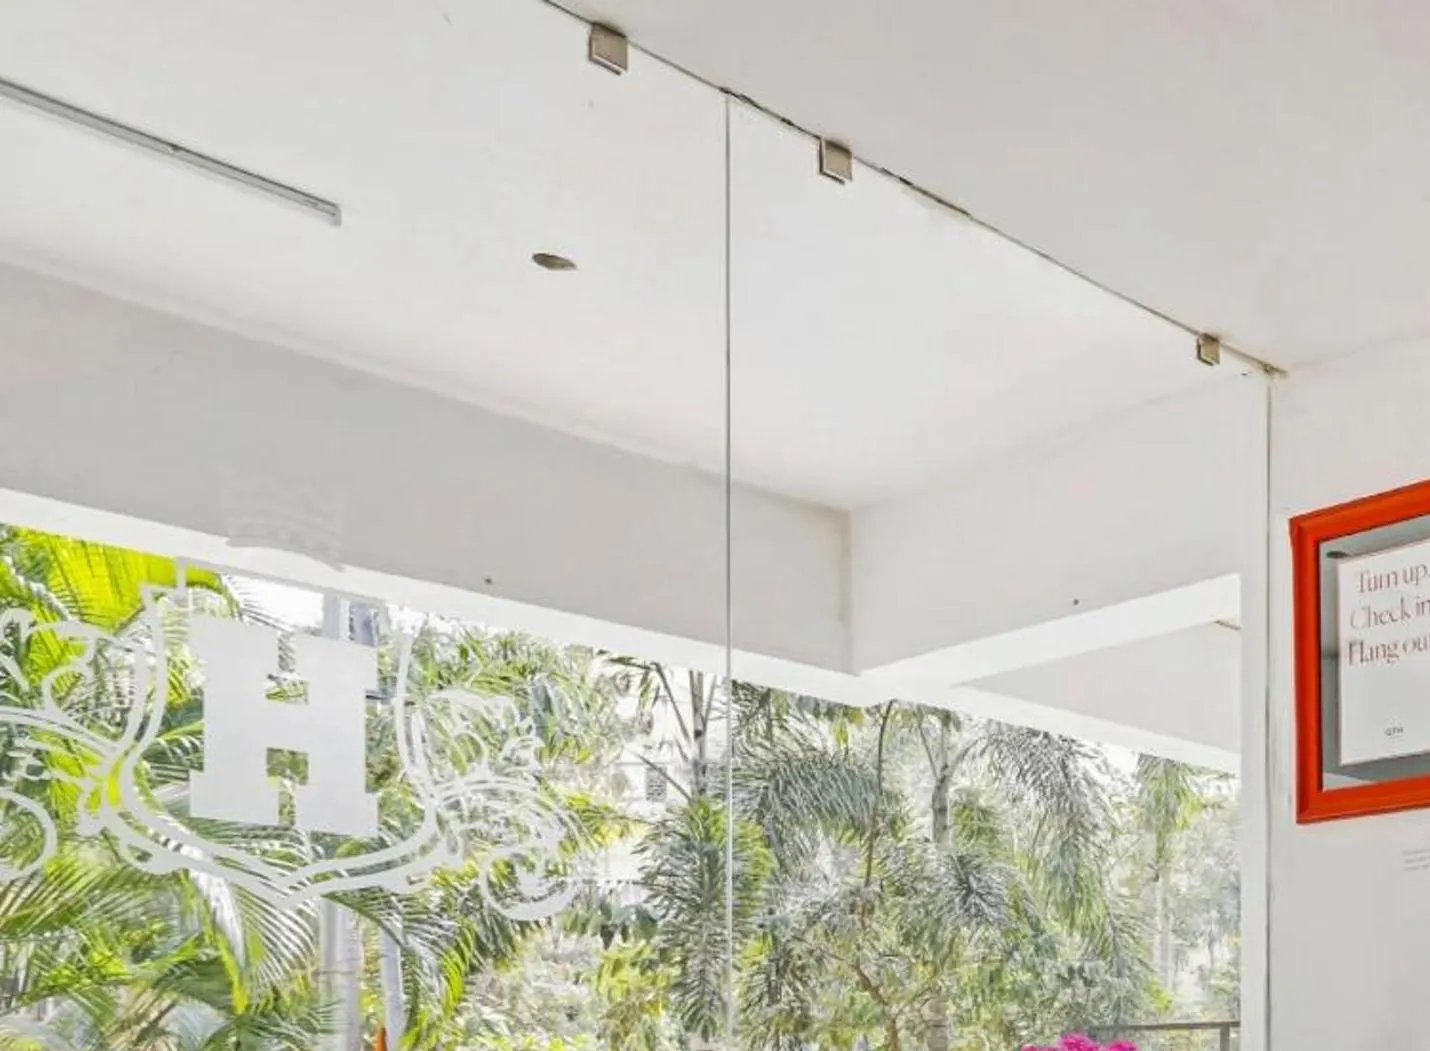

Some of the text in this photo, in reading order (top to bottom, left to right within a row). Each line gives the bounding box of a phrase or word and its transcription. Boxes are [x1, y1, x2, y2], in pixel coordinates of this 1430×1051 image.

[1358, 569, 1399, 594] Turn
[1350, 597, 1411, 630] Check
[1347, 639, 1400, 666] Hang
